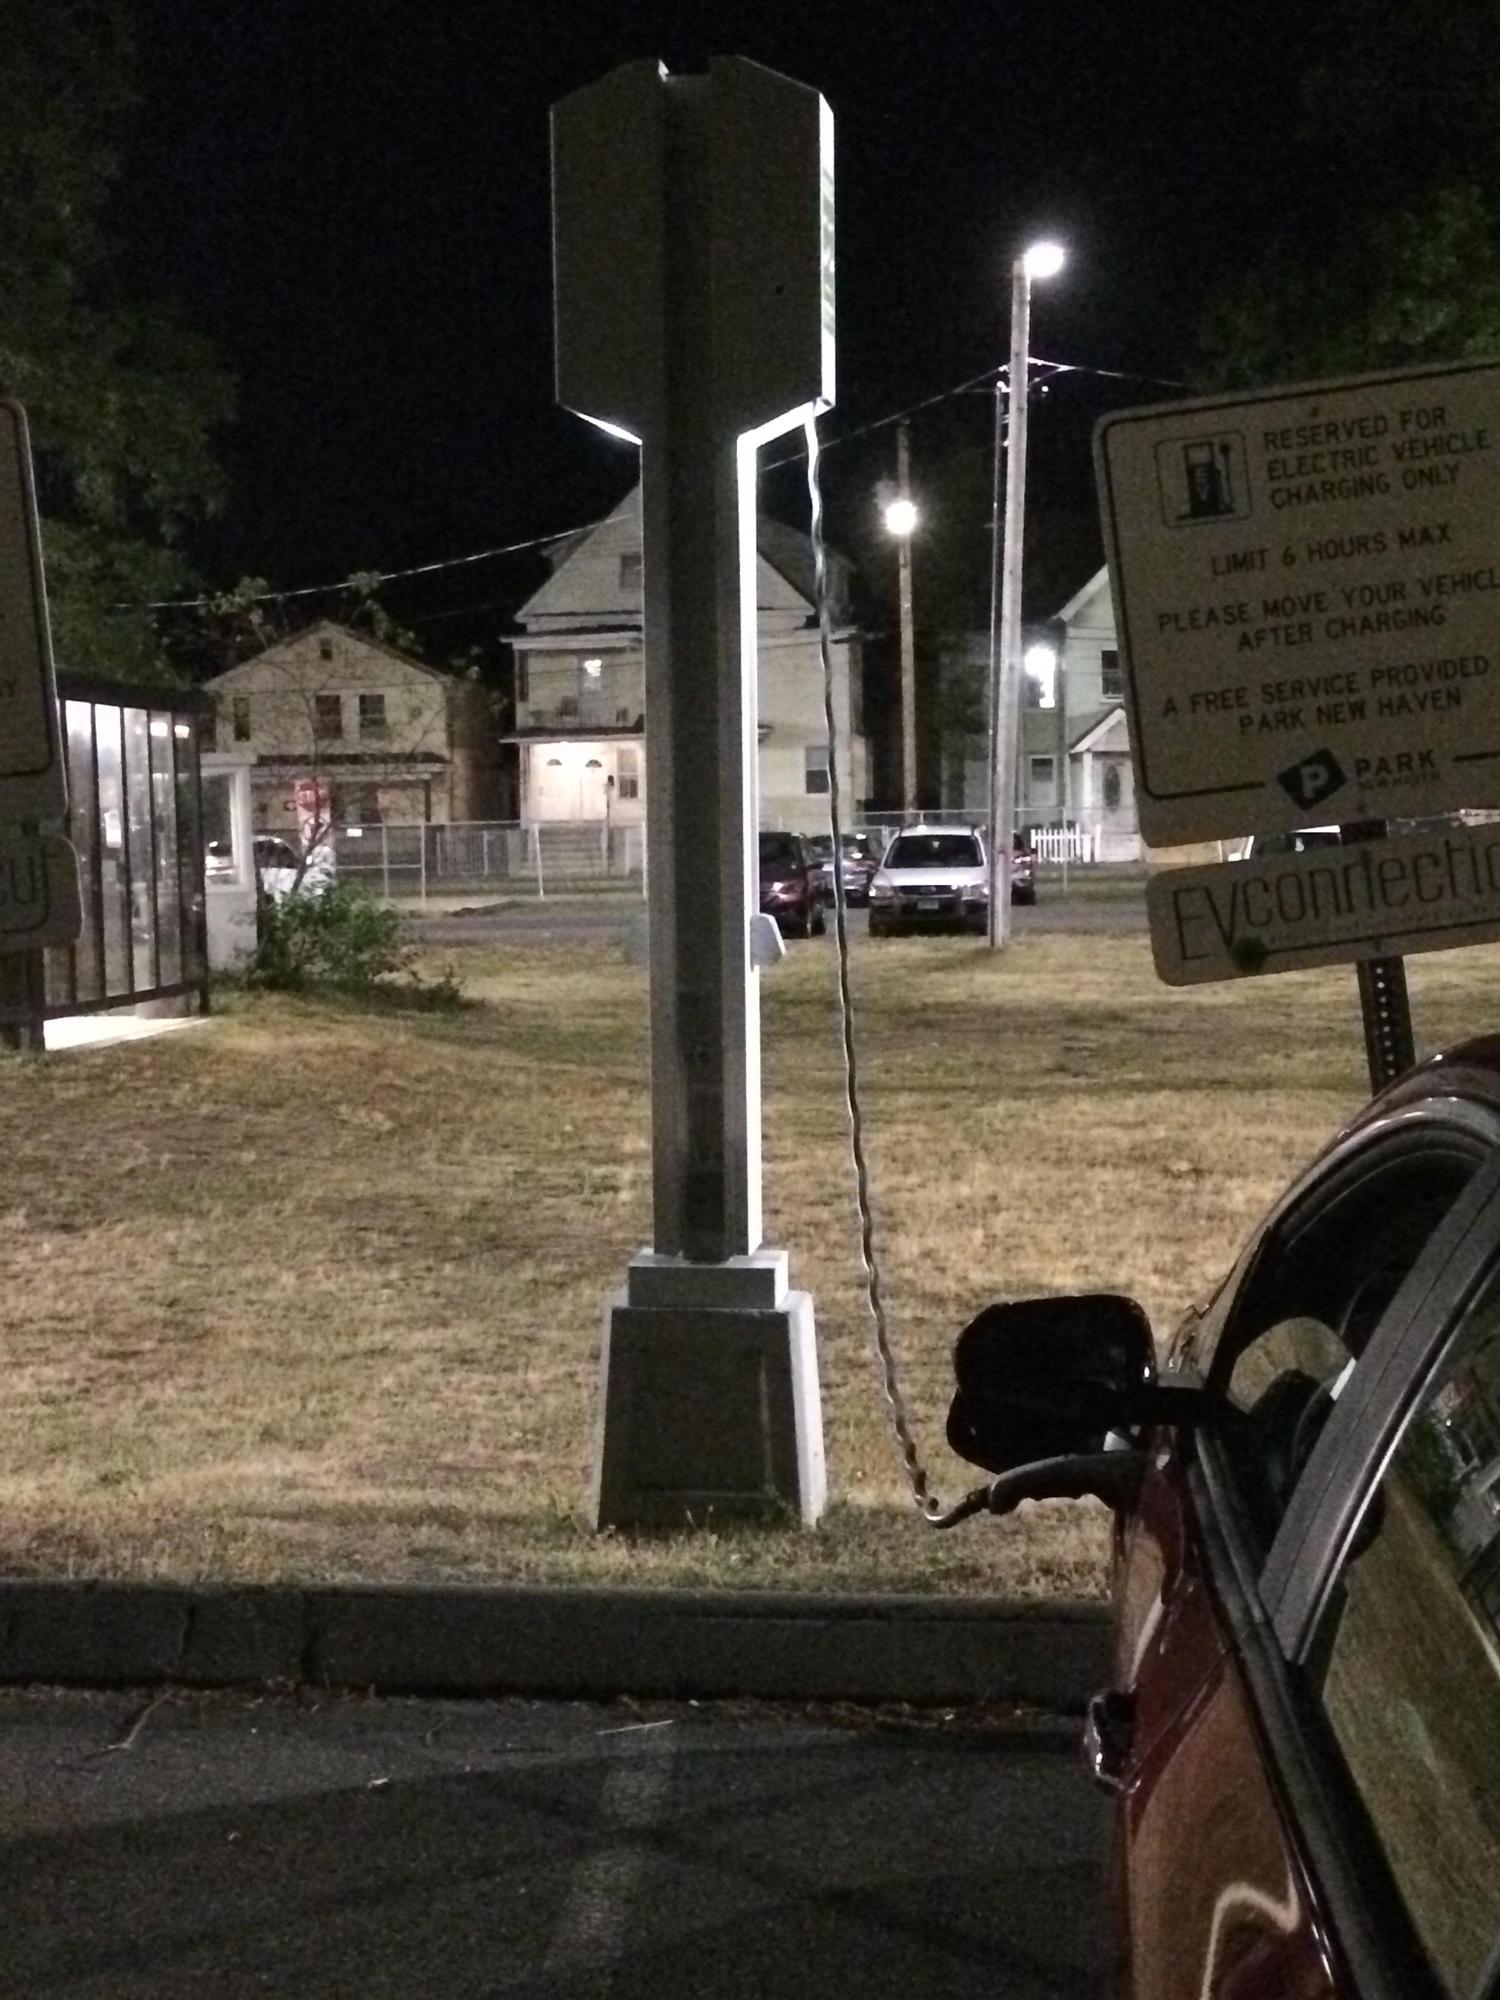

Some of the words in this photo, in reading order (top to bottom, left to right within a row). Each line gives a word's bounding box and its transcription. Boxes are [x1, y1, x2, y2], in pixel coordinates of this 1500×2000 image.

[1263, 415, 1388, 452] RESERVED
[1399, 406, 1447, 432] FOR
[1267, 445, 1378, 482] ELECTRIC
[1392, 428, 1493, 461] VEHICLE
[1270, 472, 1390, 510] CHARGING
[1402, 462, 1461, 491] ONLY
[1211, 548, 1268, 577] LIMIT
[1281, 546, 1297, 567] 6
[1308, 531, 1387, 563] HOURS
[1397, 522, 1452, 549] MAX
[1158, 602, 1250, 633] PLEASE
[1263, 591, 1329, 620] MOVE
[1341, 580, 1407, 608] YOUR
[1418, 566, 1500, 597] VEHICL
[1238, 624, 1313, 652] AFTER
[1325, 604, 1446, 640] CHARGING
[1162, 696, 1179, 718] A
[1190, 686, 1249, 714] FREE
[1261, 671, 1360, 705] SERVICE
[1370, 655, 1490, 689] PROVIDED
[1239, 707, 1304, 735] PARK
[1315, 699, 1367, 726] NEW
[1378, 686, 1463, 717] HAVEN
[1300, 763, 1330, 799] P
[1354, 749, 1436, 778] PARK
